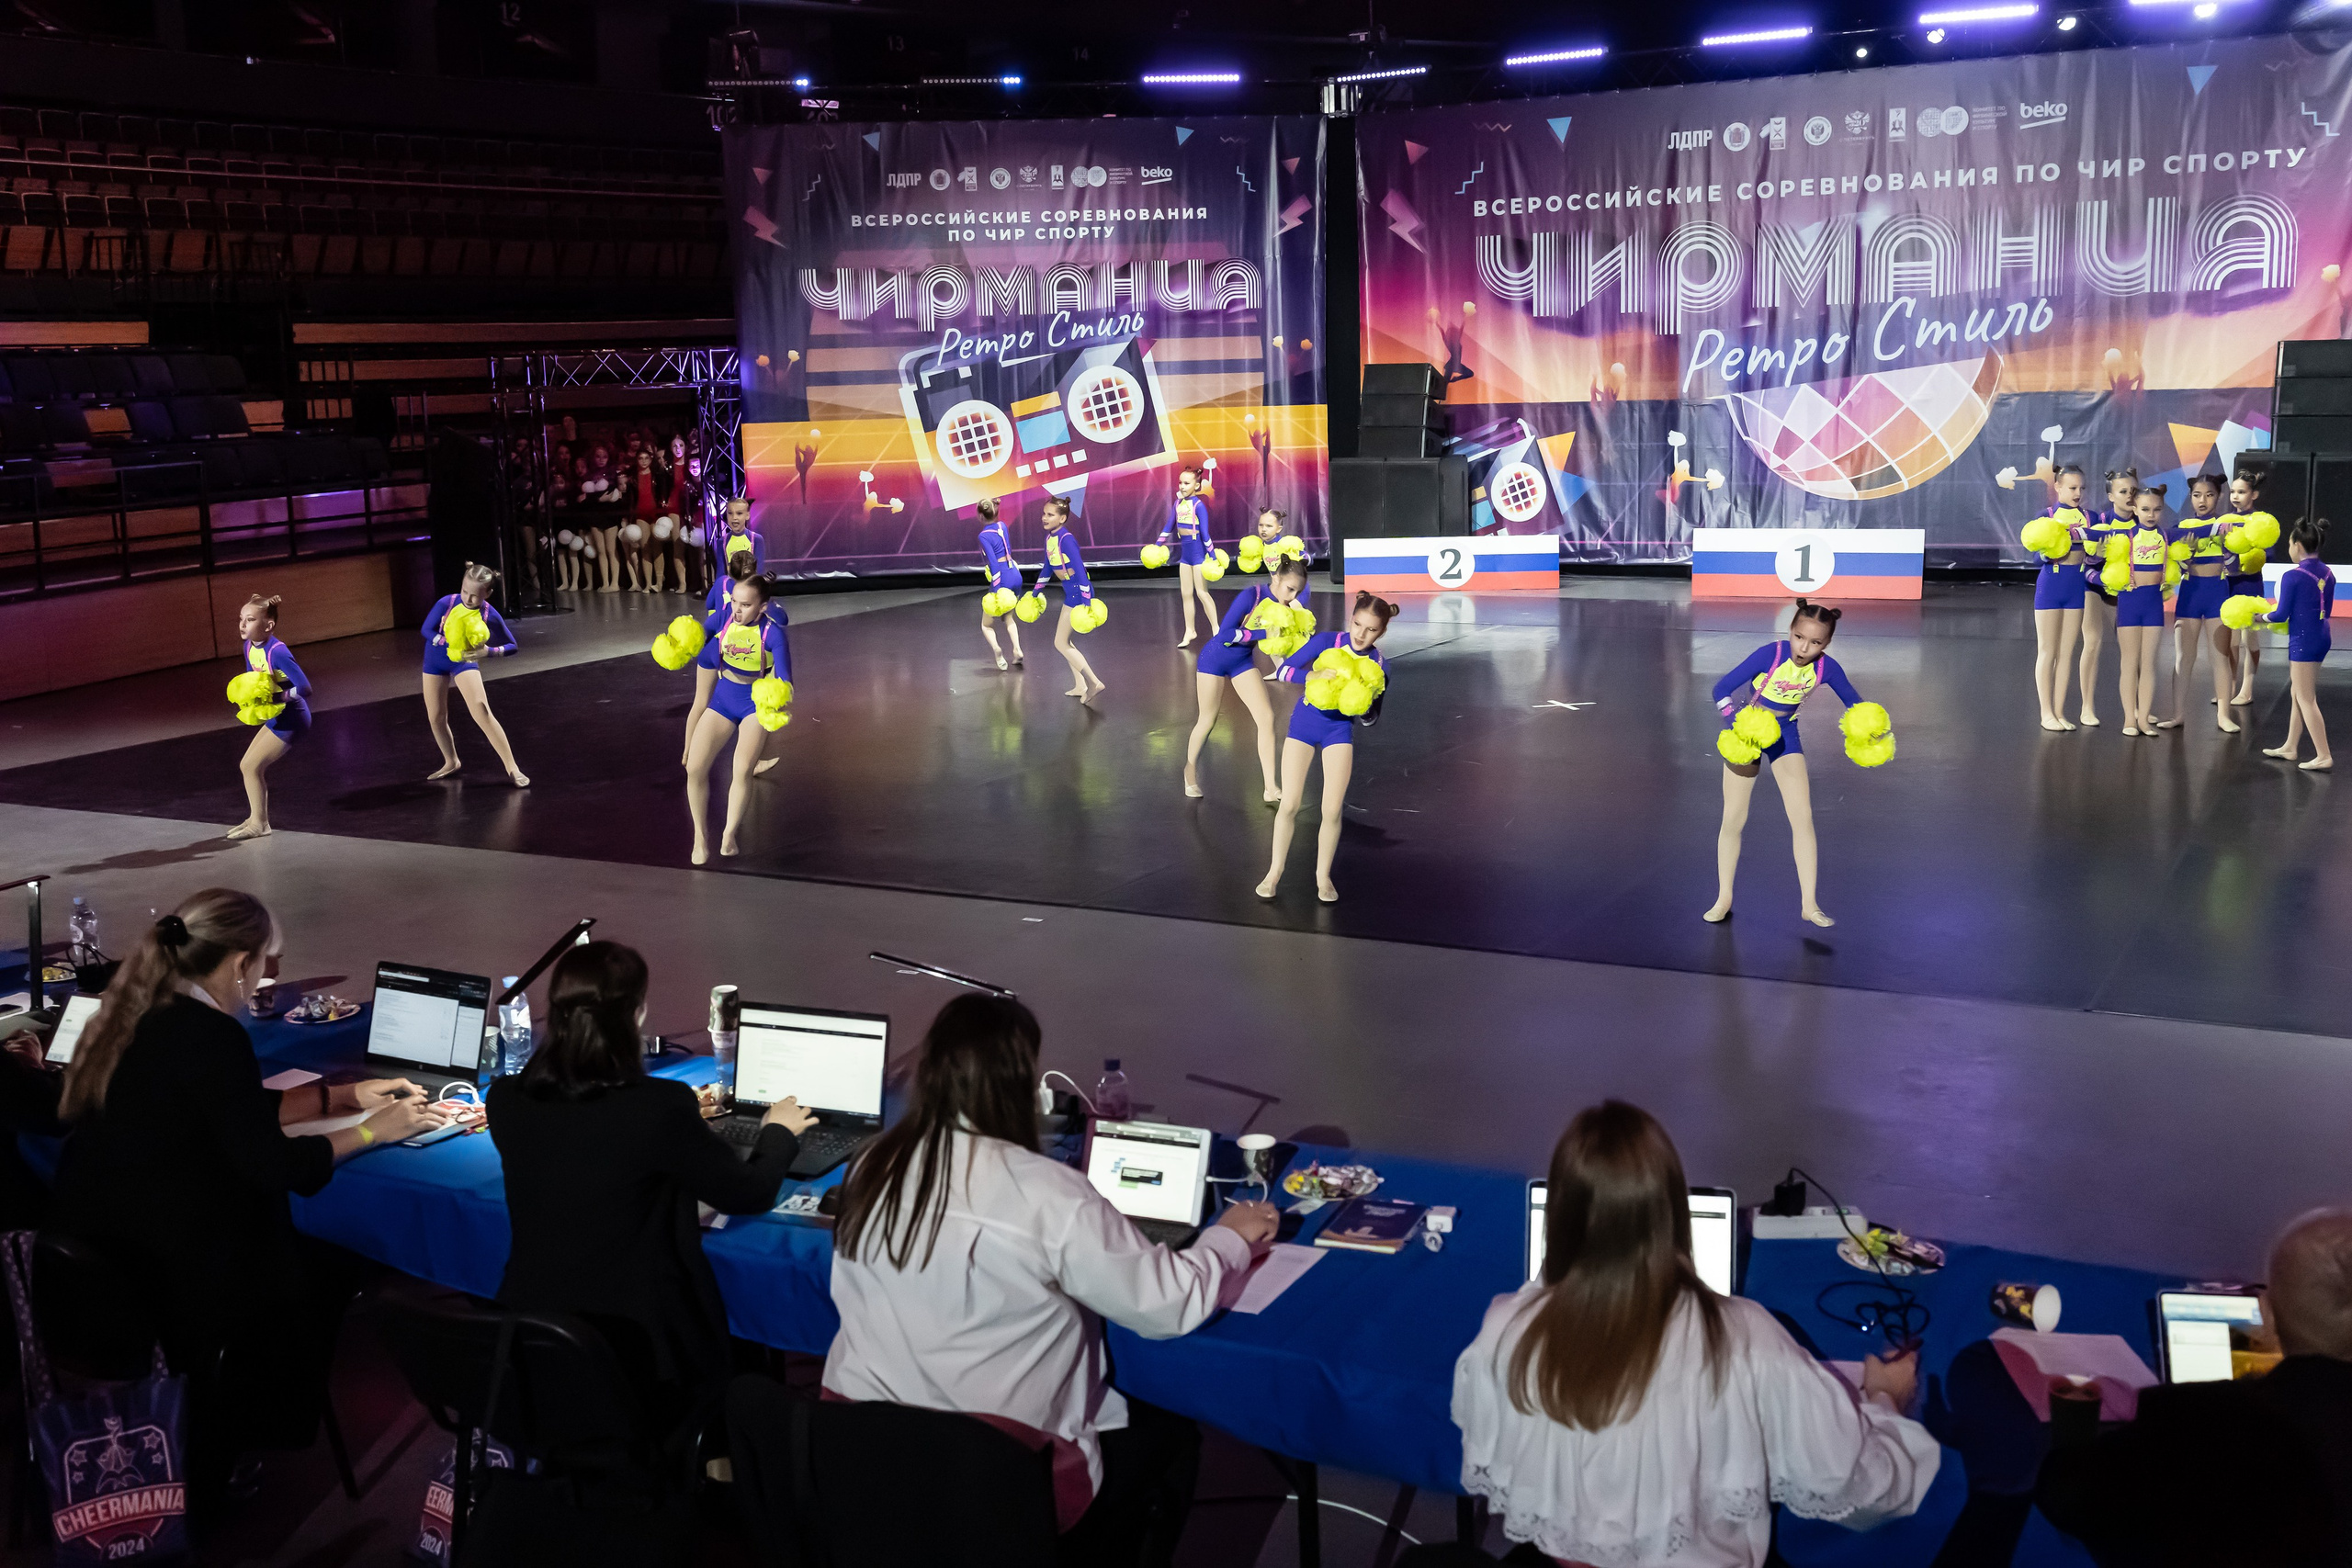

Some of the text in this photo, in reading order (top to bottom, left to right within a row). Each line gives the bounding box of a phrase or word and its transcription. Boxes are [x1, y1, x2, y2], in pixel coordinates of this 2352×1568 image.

[499, 2, 521, 22] 12
[2019, 101, 2068, 118] beko
[1668, 130, 1713, 151] ЛДПР
[886, 173, 922, 188] ЛДПР
[1140, 166, 1173, 177] beko
[1473, 147, 2308, 217] ВСЕРОССИЙСКИЕ СОРЕВНОВАНИЯ ПО ЧИР СПОРТУ
[851, 208, 1208, 227] ВСЕРОССИЙСКИЕ СОРЕВНОВАНИЯ
[948, 226, 1115, 242] ПО ЧИР СПОРТУ
[936, 310, 1145, 367] Ретро Стиль
[1682, 296, 2054, 393] Ретро Стиль
[1439, 547, 1463, 581] 2
[1792, 544, 1815, 582] 1
[56, 1487, 185, 1537] CHEERMANIA
[107, 1537, 145, 1561] 2024
[420, 1531, 442, 1556] 2024
